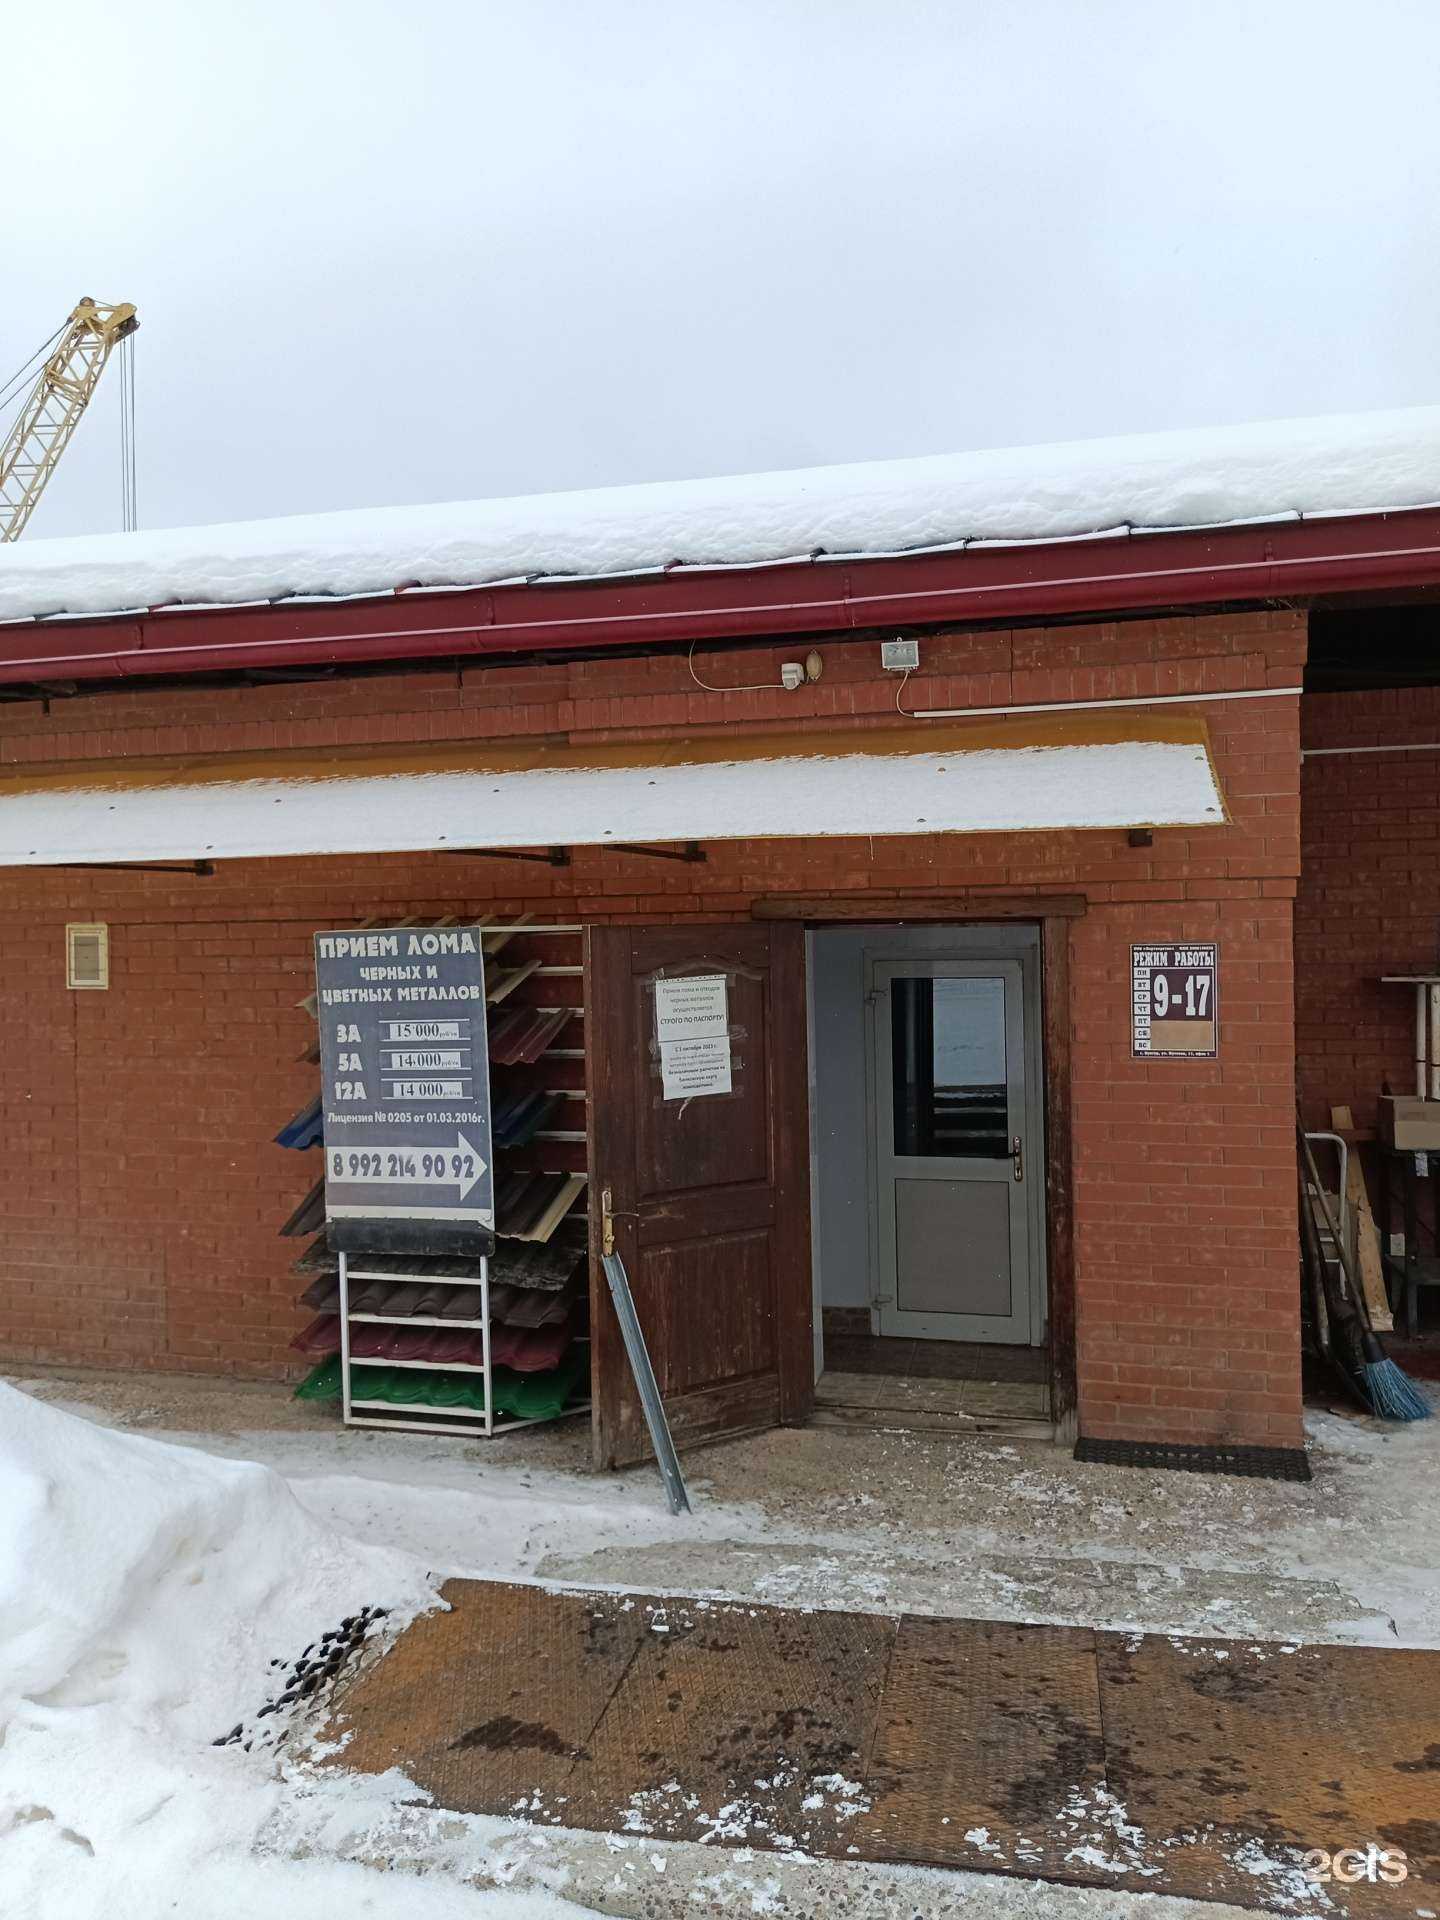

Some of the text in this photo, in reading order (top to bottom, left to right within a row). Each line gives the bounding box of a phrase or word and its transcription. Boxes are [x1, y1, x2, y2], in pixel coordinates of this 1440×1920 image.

[319, 932, 476, 959] ПРИЕМ ЛОМА
[1133, 951, 1214, 967] РЕЖИМ РАБОТЫ
[359, 965, 438, 981] ЧЕРНЫХ И
[322, 985, 480, 1006] ЦВЕТНЫХ МЕТАЛЛОВ
[1153, 974, 1211, 1017] 9-17
[660, 1017, 683, 1025] СТРОГО
[336, 1024, 362, 1043] 3А
[338, 1053, 363, 1072] 5А
[335, 1081, 367, 1100] 12А
[327, 1112, 374, 1124] Лицензия
[414, 1113, 424, 1122] от
[333, 1153, 475, 1178] 8 992 214 90 92
